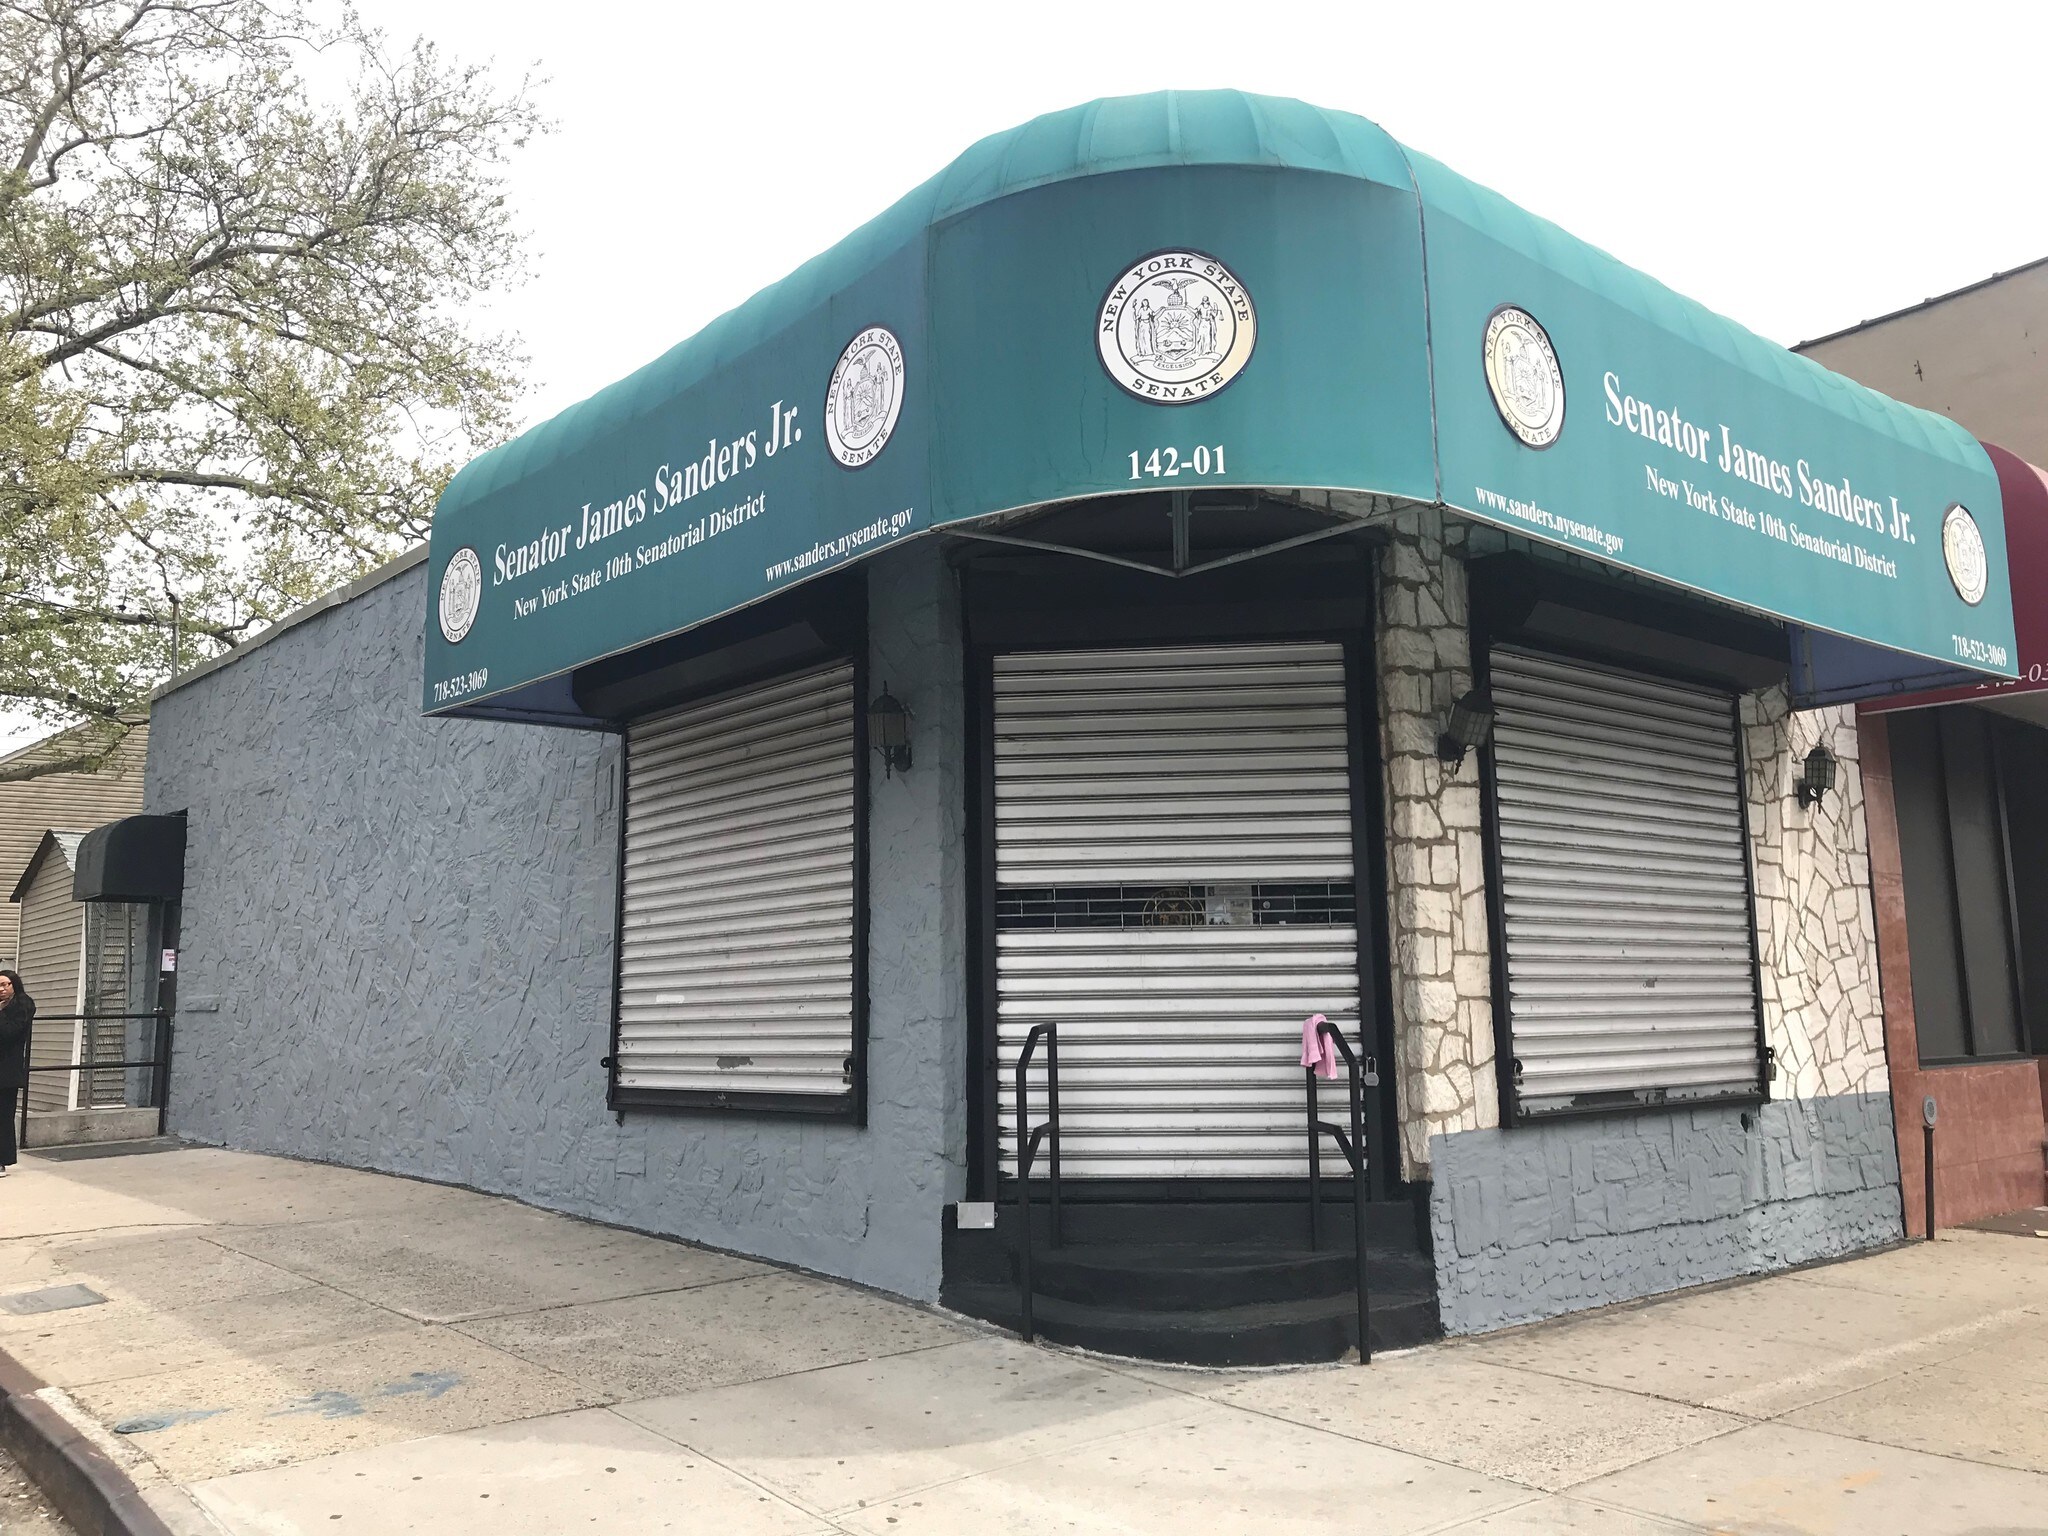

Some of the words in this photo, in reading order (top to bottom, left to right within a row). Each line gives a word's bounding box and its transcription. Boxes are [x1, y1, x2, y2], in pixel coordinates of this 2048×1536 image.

[1103, 284, 1128, 332] NEW
[1132, 256, 1194, 281] YORK
[1203, 264, 1249, 322] STATE
[827, 370, 841, 414] NEW
[842, 331, 875, 364] YORK
[878, 332, 902, 376] STATE
[1132, 371, 1224, 398] SENATE
[1486, 320, 1498, 360] NEW
[1500, 311, 1531, 330] YORK
[1536, 331, 1561, 389] STATE
[841, 428, 888, 463] SENATE
[1127, 444, 1226, 481] 142-01
[1506, 412, 1552, 443] SENATE
[1603, 371, 1710, 464] Senator
[1718, 423, 1793, 498] James
[1797, 459, 1885, 534] Sanders
[1889, 495, 1916, 545] Jr.
[493, 524, 572, 587] Senator
[576, 488, 647, 550] James
[653, 429, 757, 515] Sanders
[764, 399, 802, 457] Jr.
[1475, 486, 1624, 555] www.sanders.nysenate.gov
[1645, 464, 1679, 500] New
[1681, 479, 1719, 517] York
[1720, 496, 1756, 531] State
[1758, 511, 1788, 543] 10th
[1790, 522, 1852, 565] Senatorial
[1853, 545, 1898, 579] District
[513, 596, 539, 620] New
[541, 580, 569, 609] York
[571, 568, 602, 596] State
[605, 552, 632, 583] 10th
[636, 518, 705, 570] Senatorial
[709, 490, 766, 538] District
[765, 507, 913, 582] www.sanders.nysenate.gov
[433, 667, 488, 703] 718-523-3069
[1952, 634, 2007, 667] 718-523-3069
